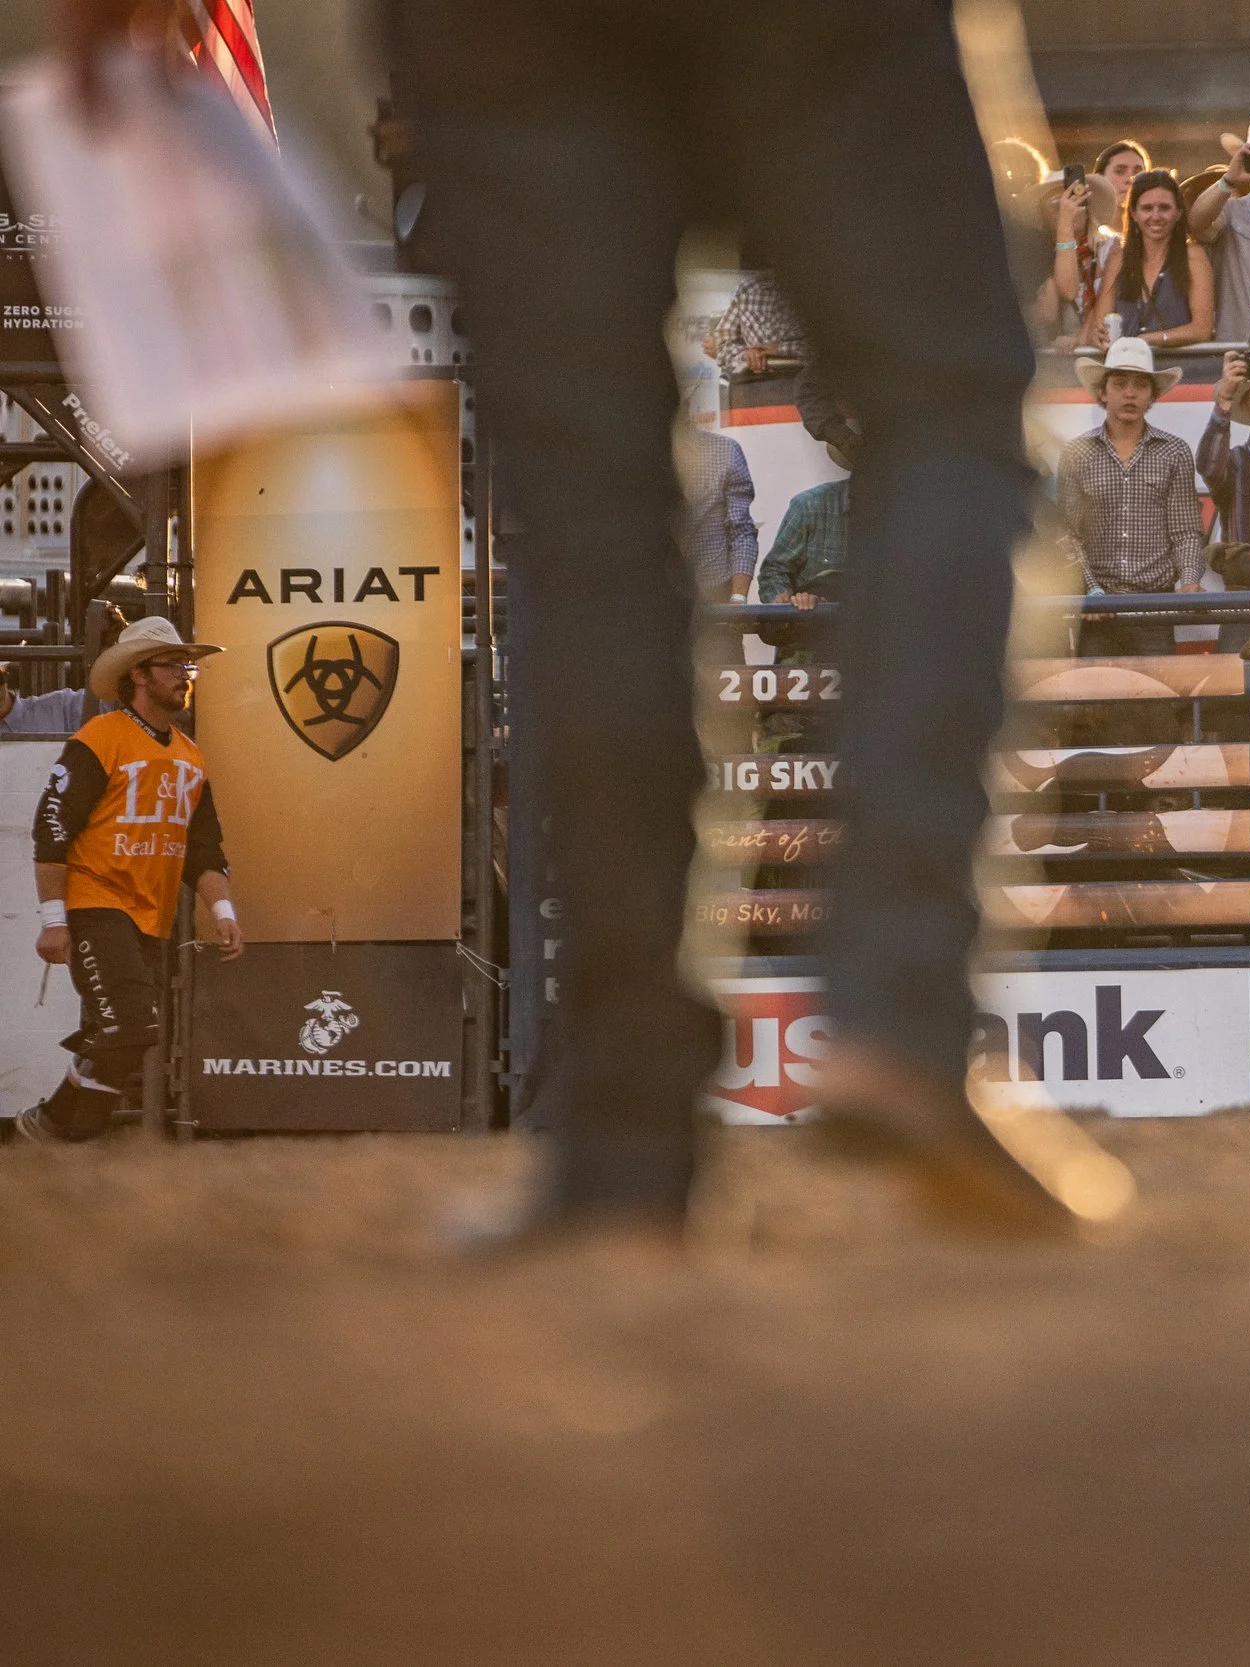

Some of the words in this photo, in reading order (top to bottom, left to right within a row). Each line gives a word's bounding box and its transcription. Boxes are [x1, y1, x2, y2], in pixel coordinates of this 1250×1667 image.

[4, 305, 40, 315] ZERO
[4, 318, 84, 328] HYDRATION
[226, 566, 440, 604] ARIAT
[719, 669, 842, 701] 2022
[770, 760, 840, 790] SKY
[113, 832, 156, 857] Real
[778, 825, 809, 862] of
[737, 904, 783, 924] Sky,
[968, 985, 1172, 1081] ank
[203, 1058, 451, 1077] MARINES.COM
